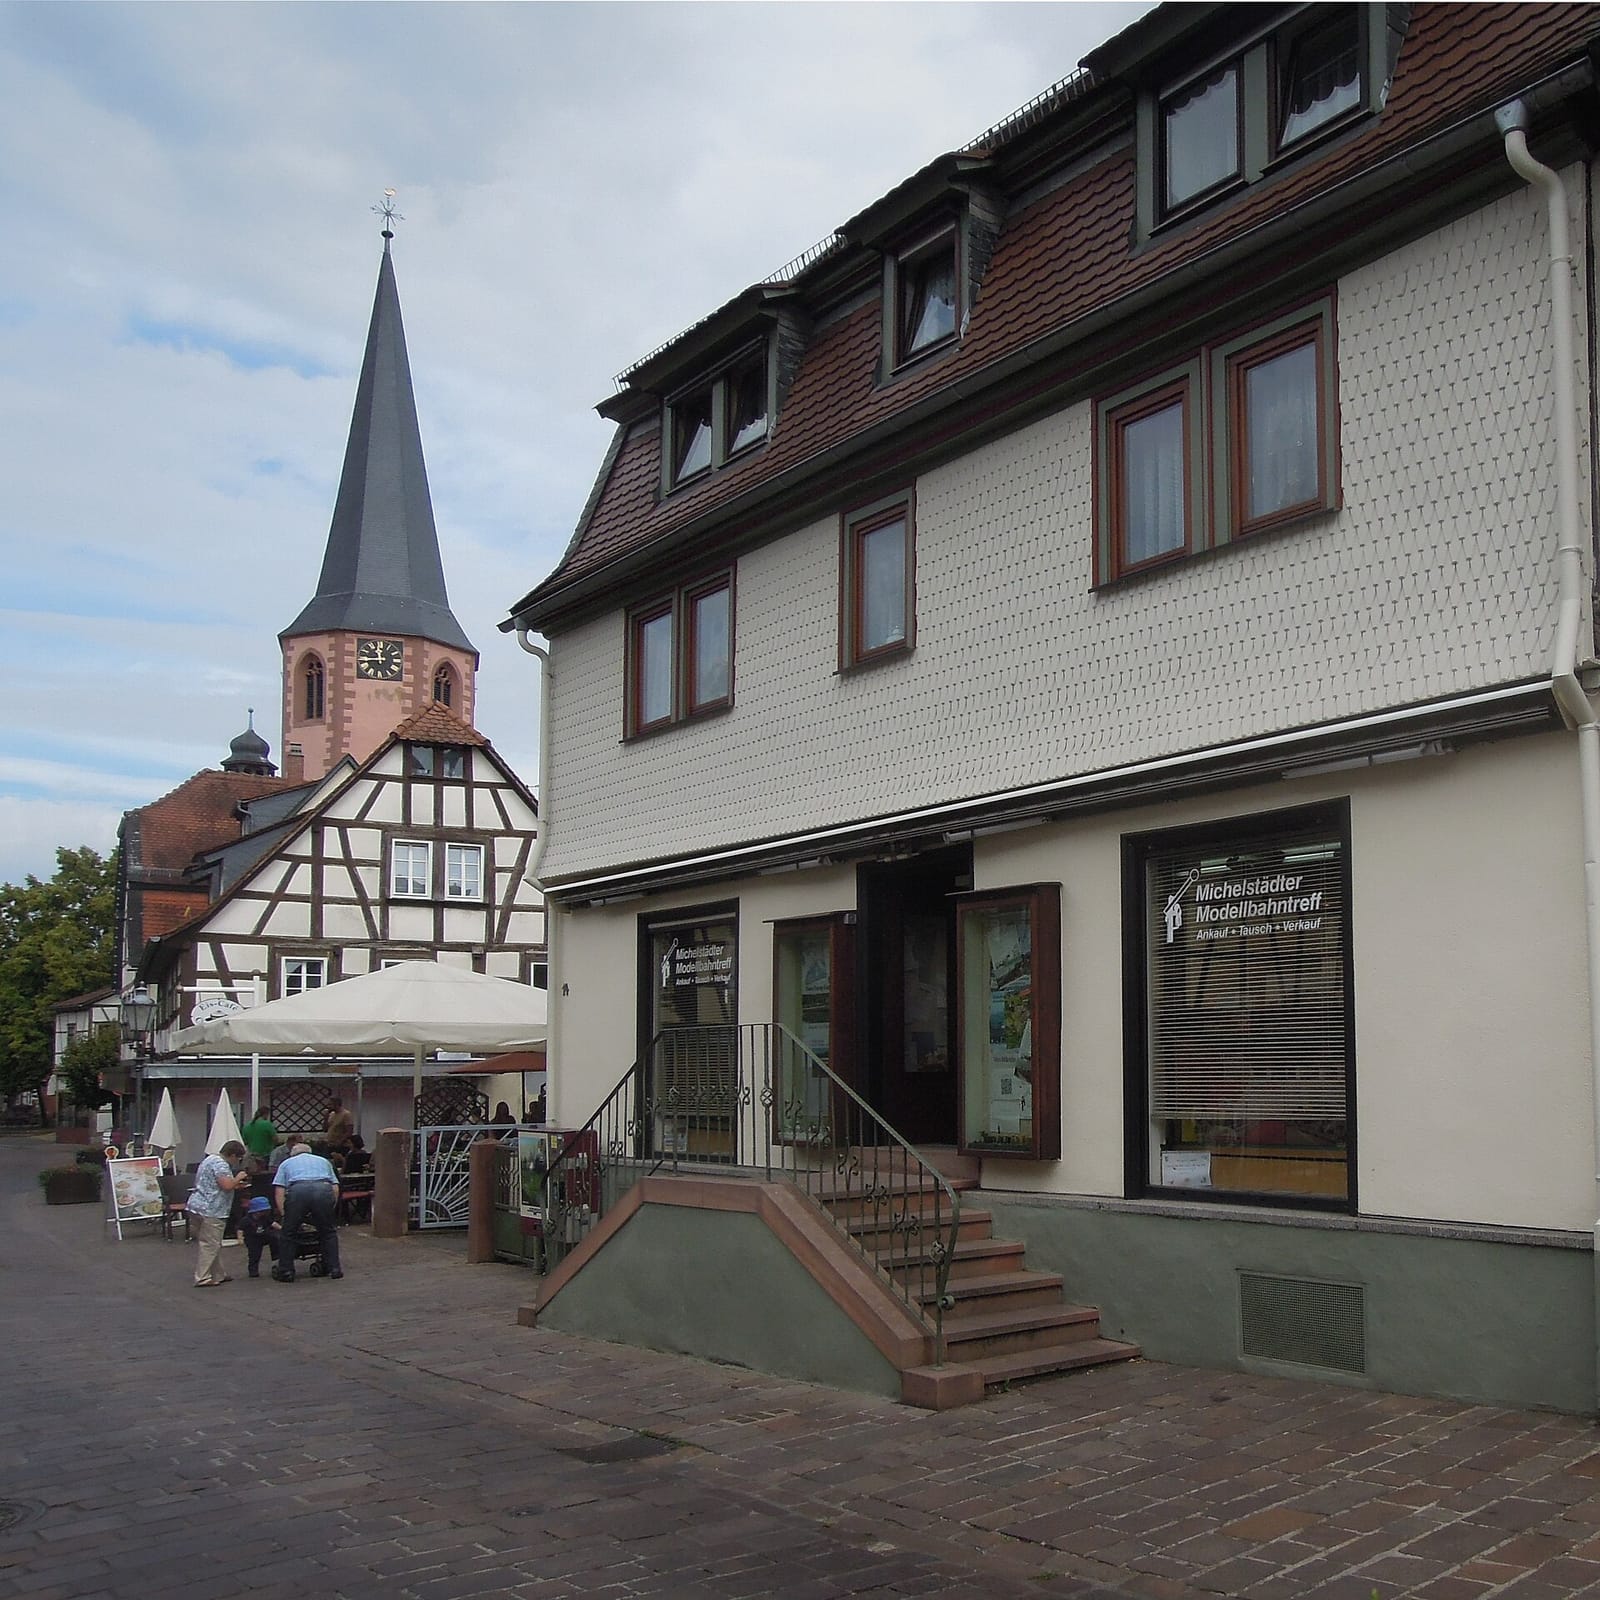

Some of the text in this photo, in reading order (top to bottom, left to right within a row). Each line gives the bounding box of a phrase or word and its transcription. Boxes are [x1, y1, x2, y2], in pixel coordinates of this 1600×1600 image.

[1195, 874, 1303, 902] Michelstädter
[1196, 892, 1322, 923] Modellbahntreff
[1196, 917, 1321, 940] Ankauf Tausch Verkauf
